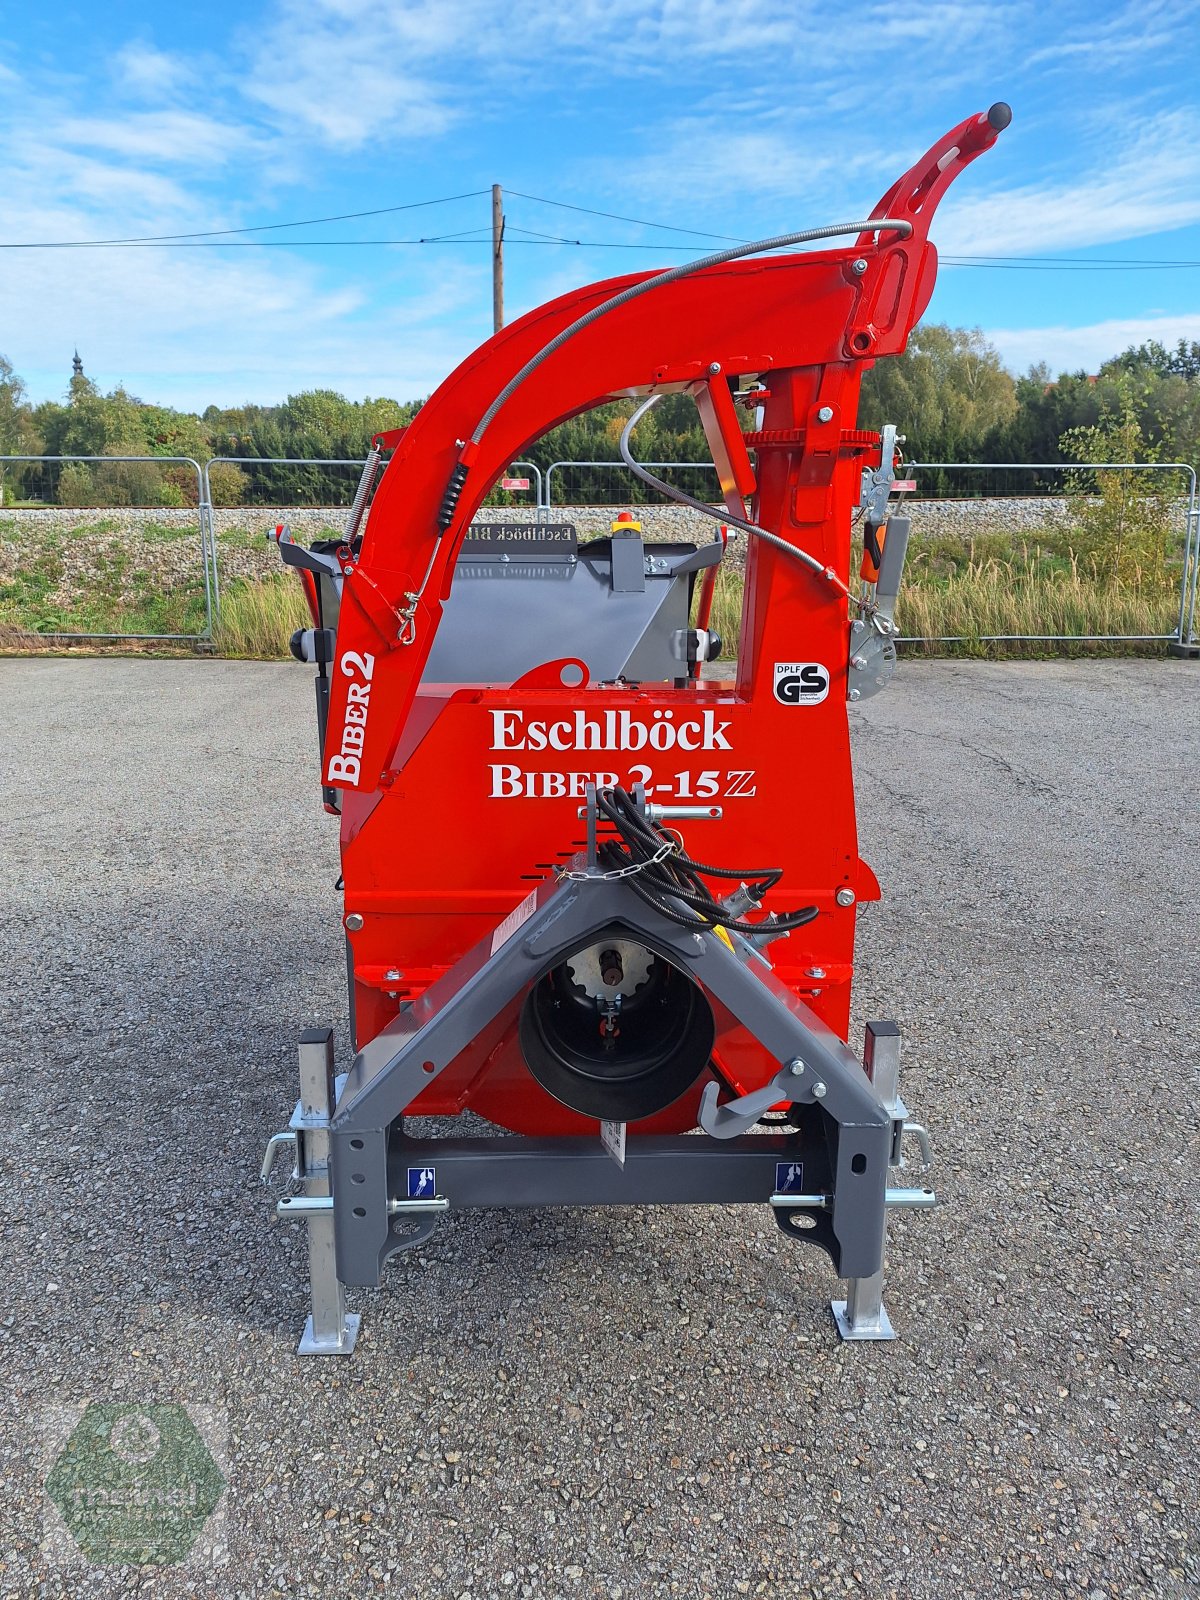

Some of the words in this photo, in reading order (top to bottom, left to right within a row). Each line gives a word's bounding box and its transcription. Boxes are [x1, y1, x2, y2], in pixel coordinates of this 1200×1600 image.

[341, 651, 375, 680] 2
[777, 665, 800, 673] DPLF
[776, 665, 827, 702] GS
[488, 710, 733, 751] Eschlböck
